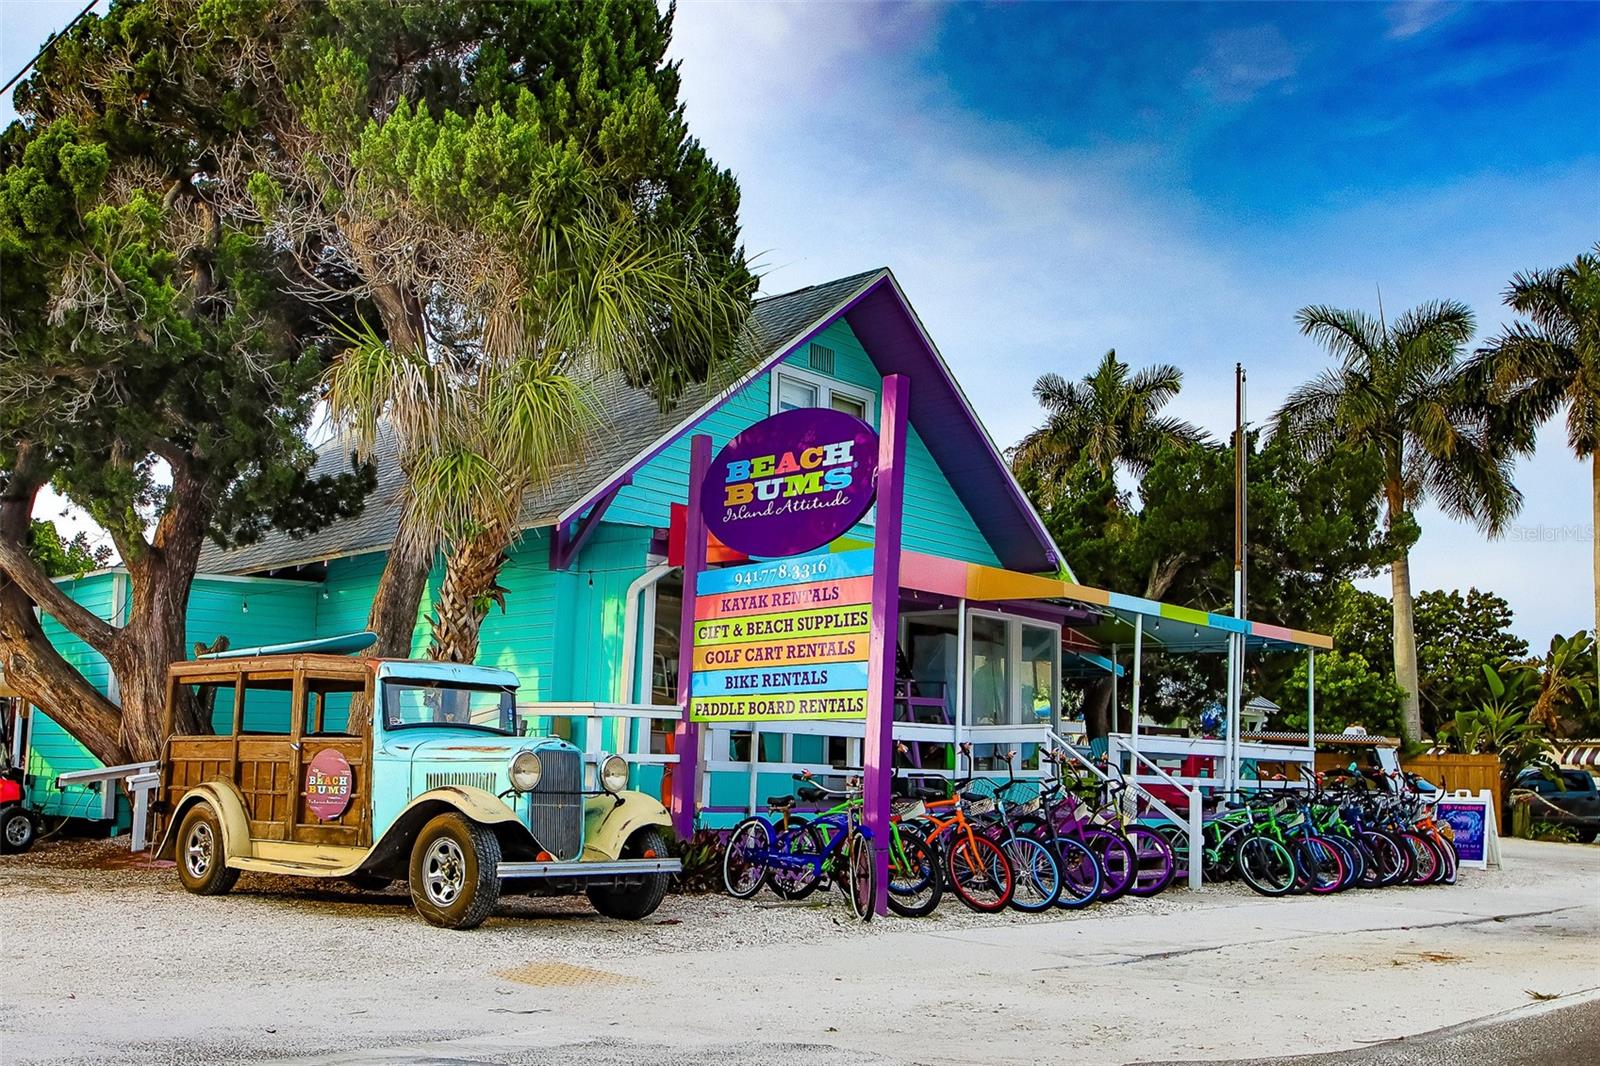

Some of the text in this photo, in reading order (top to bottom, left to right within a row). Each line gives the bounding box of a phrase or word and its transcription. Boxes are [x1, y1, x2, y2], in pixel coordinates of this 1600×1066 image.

[725, 440, 855, 483] BEACH
[723, 466, 853, 507] BUMS
[722, 491, 852, 523] Island Attitude
[735, 560, 827, 585] 941.778.3316
[721, 586, 840, 612] KAYAK RENTALS
[698, 611, 868, 640] GIFT & BEACH SUPPLIES
[705, 640, 856, 665] GOLF CART RENTALS
[725, 670, 828, 690] BIKE RENTALS
[695, 697, 864, 717] PADDLE BOARD RENTALS
[308, 786, 347, 795] BUMS
[309, 776, 347, 786] BEACH
